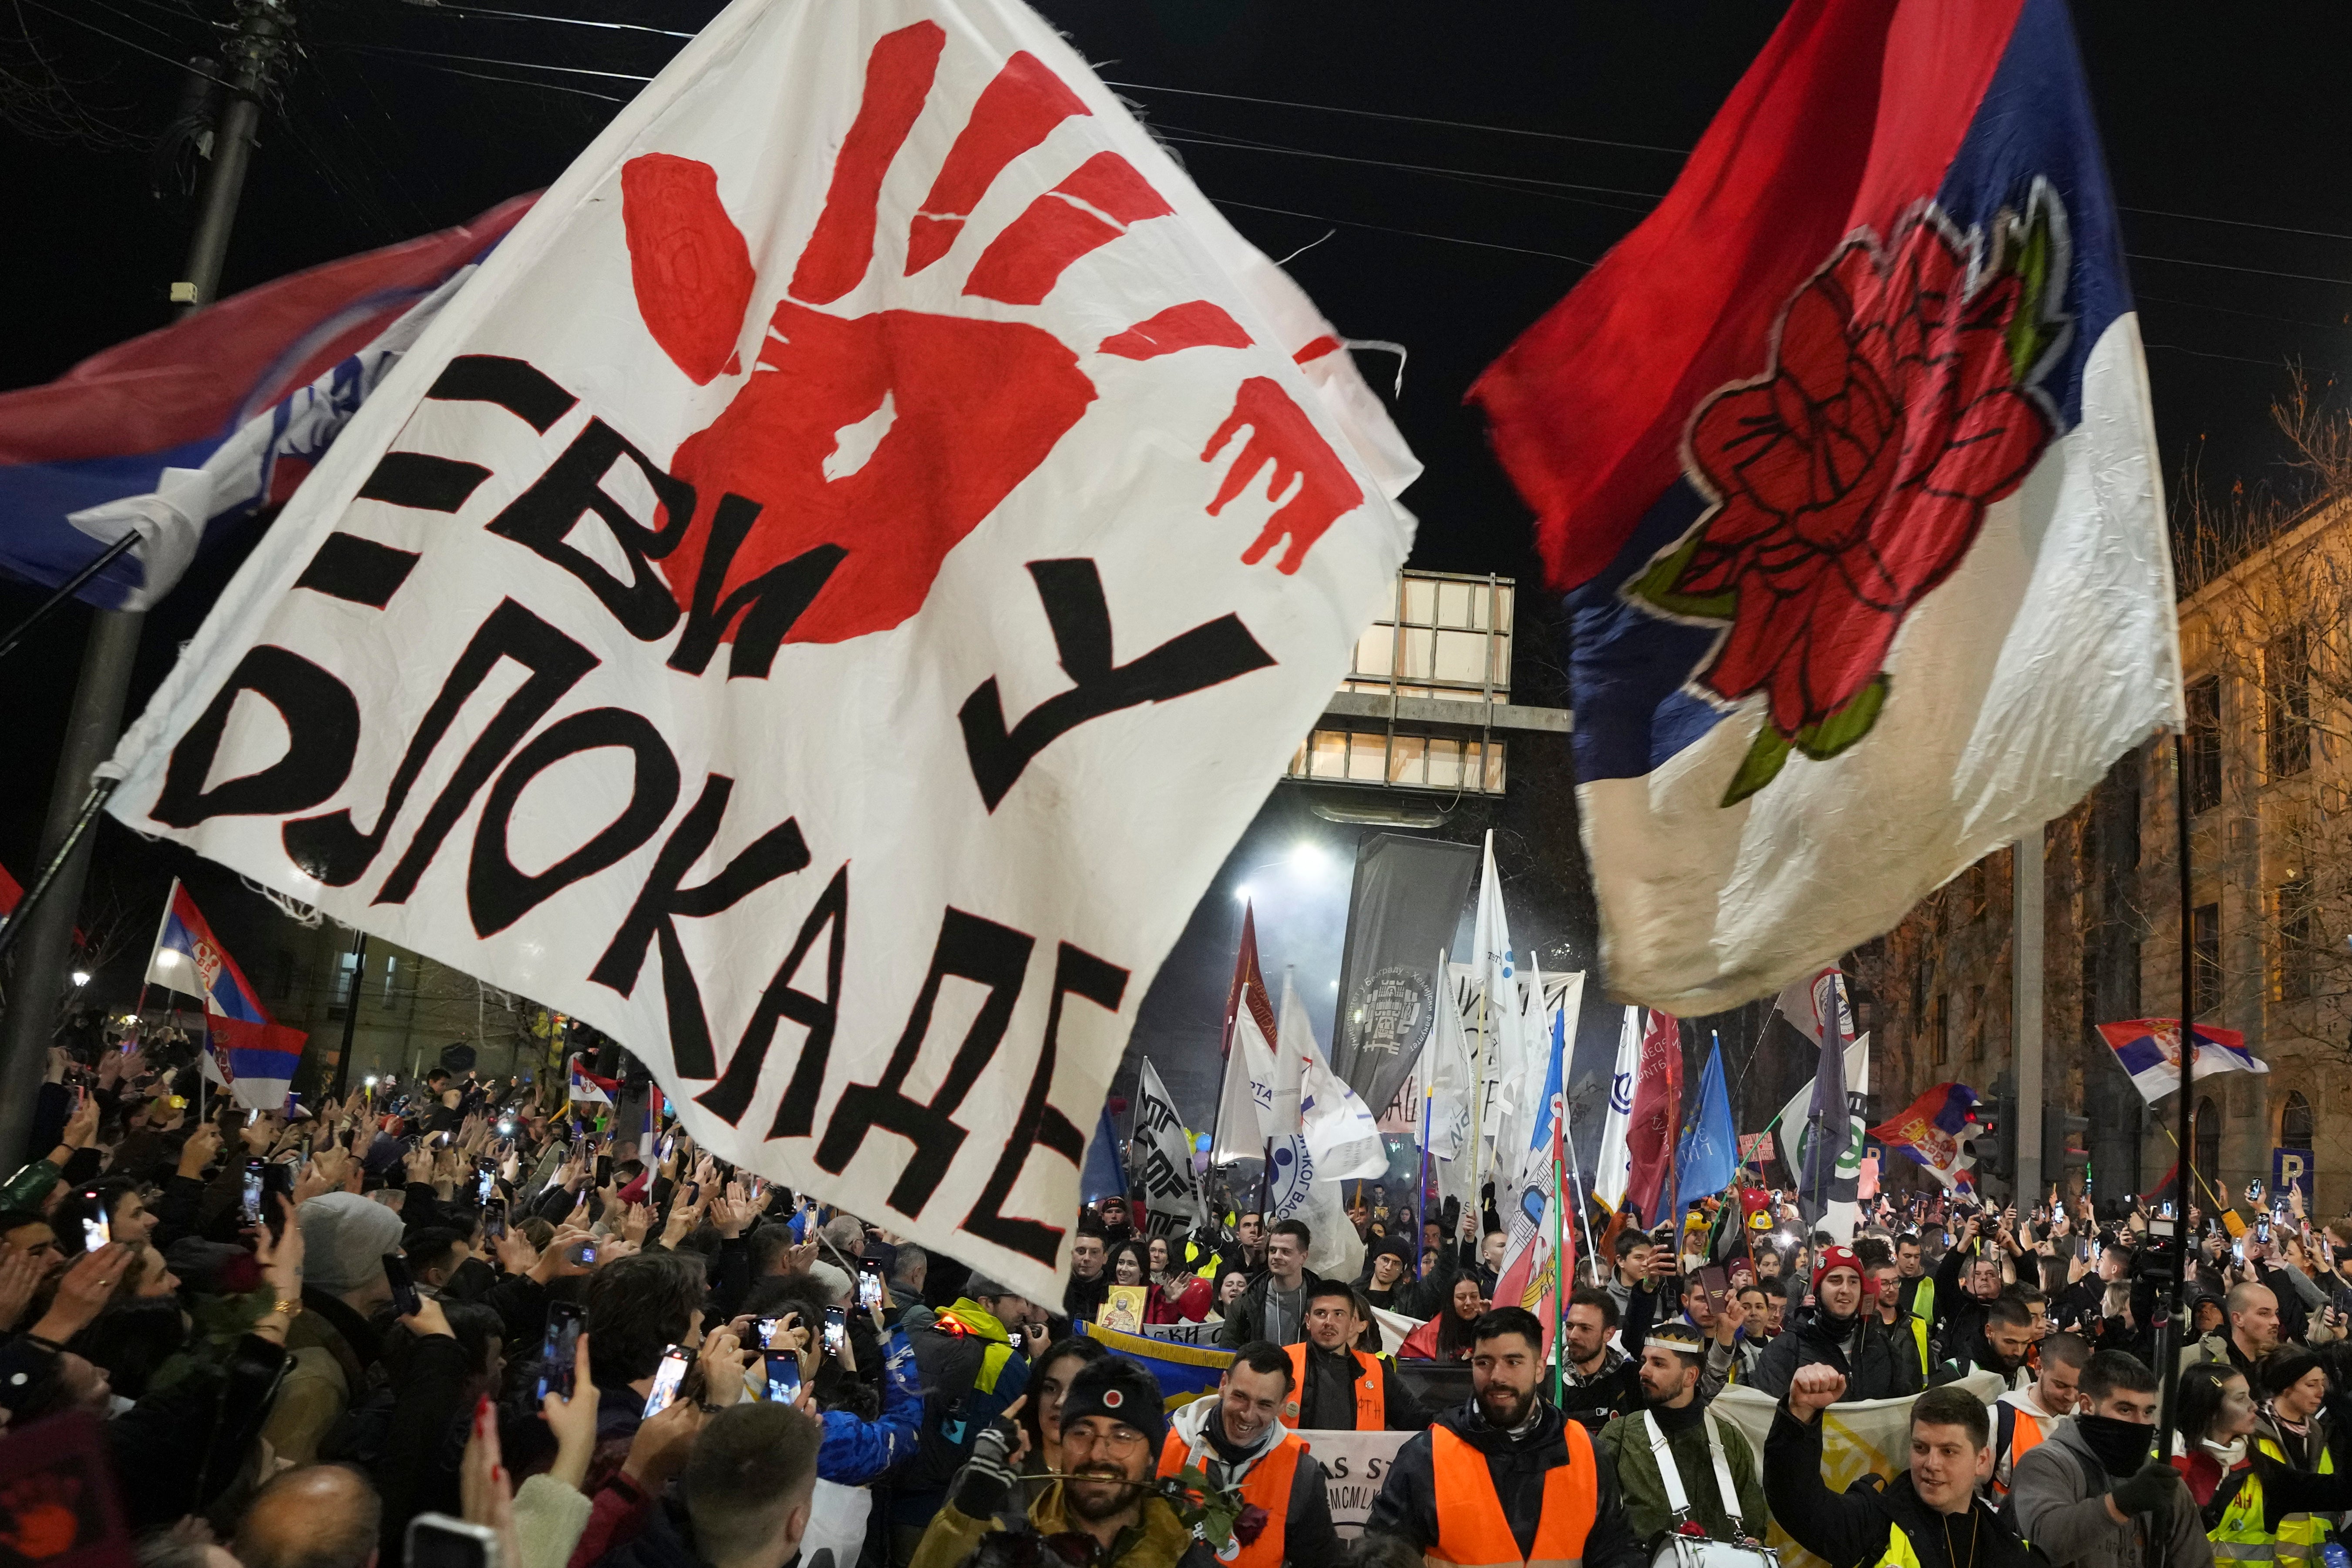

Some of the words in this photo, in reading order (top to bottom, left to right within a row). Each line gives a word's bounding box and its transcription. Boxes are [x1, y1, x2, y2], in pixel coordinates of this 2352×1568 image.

[959, 558, 1278, 814] У
[149, 531, 1131, 1271] БЛОКАДЕ
[1364, 967, 1404, 987] Београду
[1411, 971, 1433, 1011] Хемијски
[2282, 1154, 2304, 1186] P
[1357, 1396, 1381, 1419] ФТН
[1366, 1458, 1393, 1479] S
